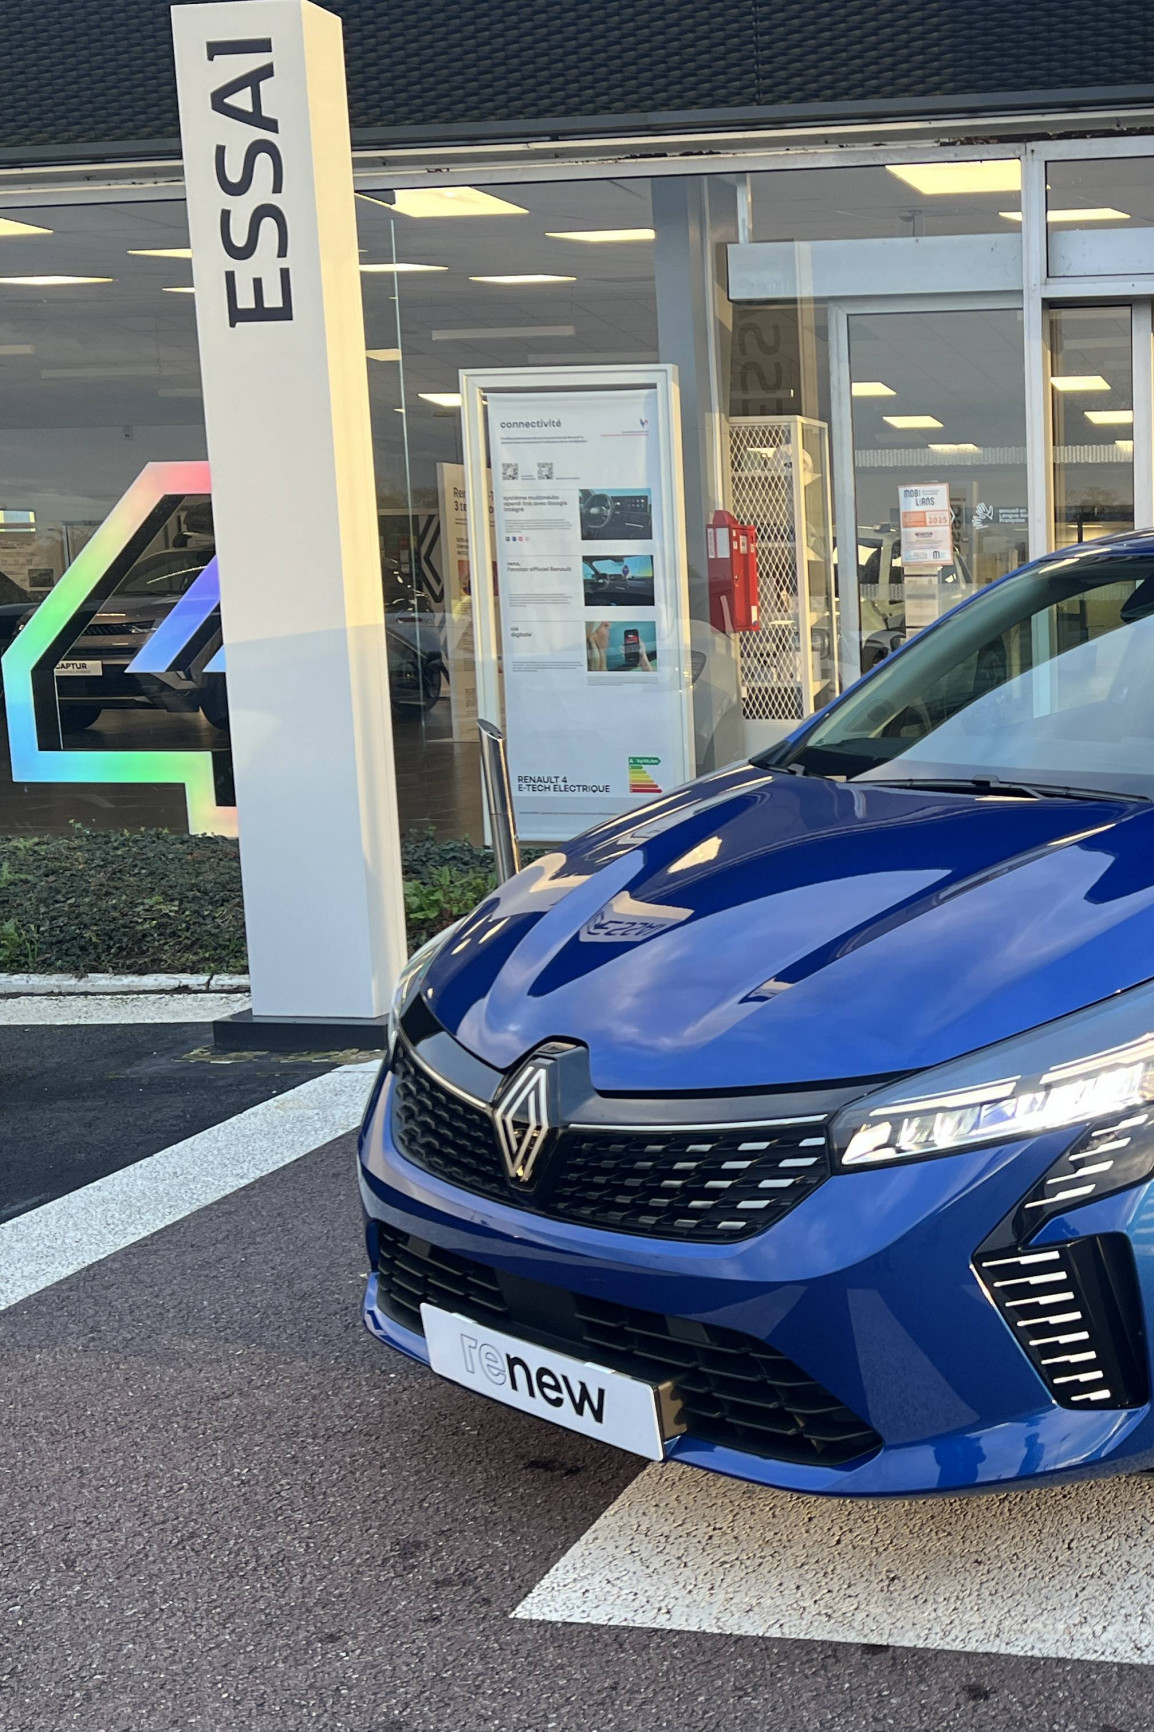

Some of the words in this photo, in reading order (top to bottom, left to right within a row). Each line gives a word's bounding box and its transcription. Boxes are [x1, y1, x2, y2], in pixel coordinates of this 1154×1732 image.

[206, 37, 293, 328] ESSAI
[500, 419, 562, 429] connectivité
[928, 516, 948, 524] 2025
[517, 775, 560, 784] RENAULT
[561, 775, 568, 784] 4
[518, 784, 551, 792] E-TECH
[553, 784, 610, 793] ELECTRIQUE
[460, 1333, 606, 1424] renew
